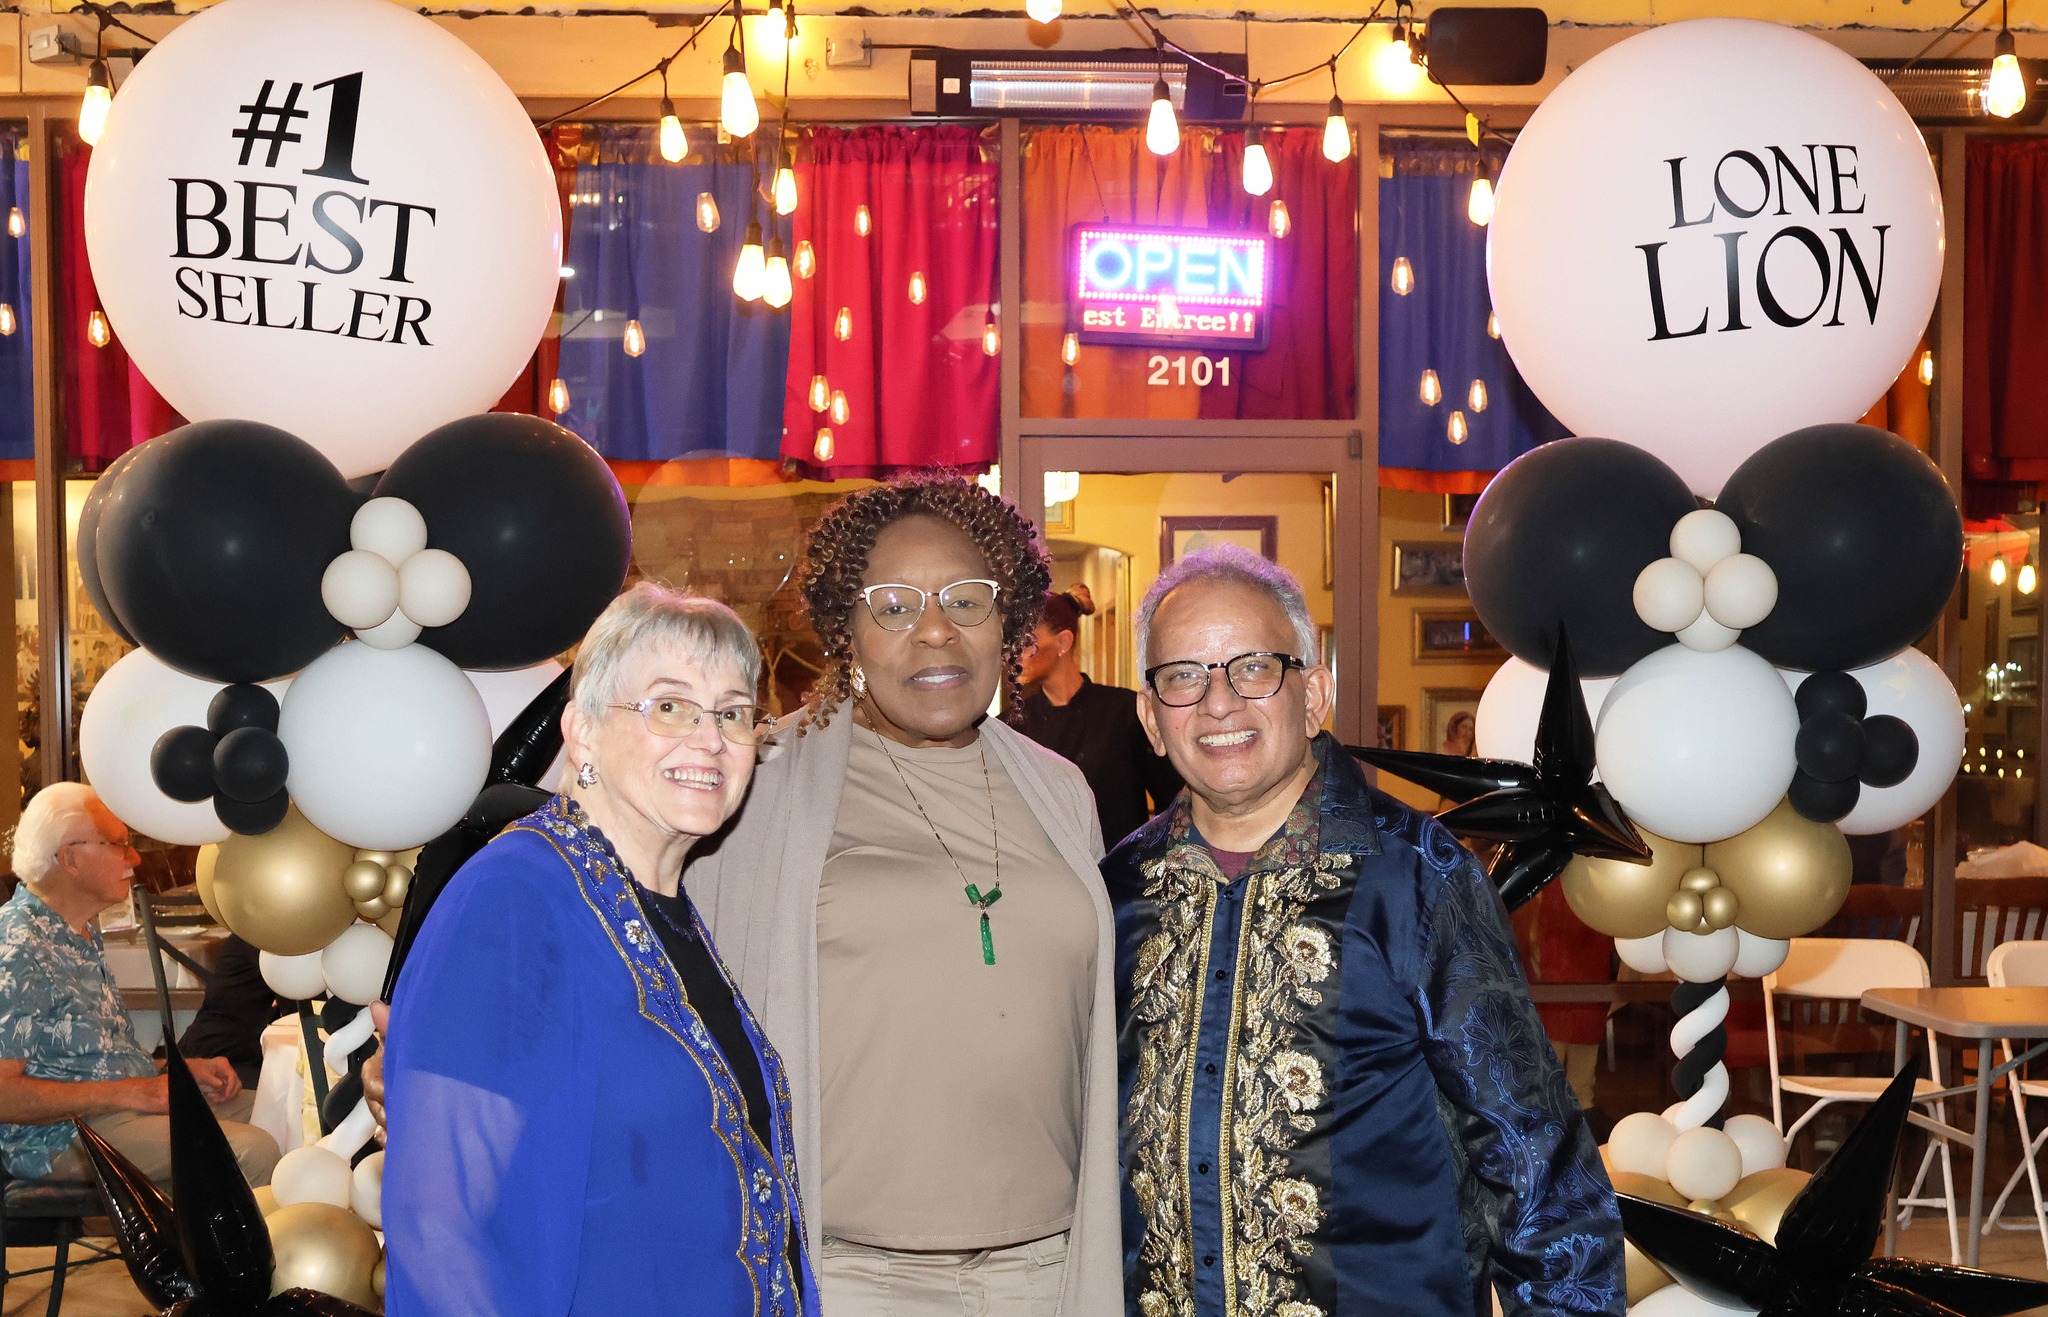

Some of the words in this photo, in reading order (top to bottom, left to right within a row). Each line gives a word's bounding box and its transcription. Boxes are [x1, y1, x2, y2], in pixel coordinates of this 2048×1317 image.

[231, 71, 370, 186] #1
[1663, 144, 1866, 230] LONE
[168, 178, 437, 284] BEST
[1085, 240, 1260, 297] OPEN
[175, 266, 434, 347] SELLER
[1634, 225, 1892, 342] LION
[1147, 355, 1231, 387] 2101
